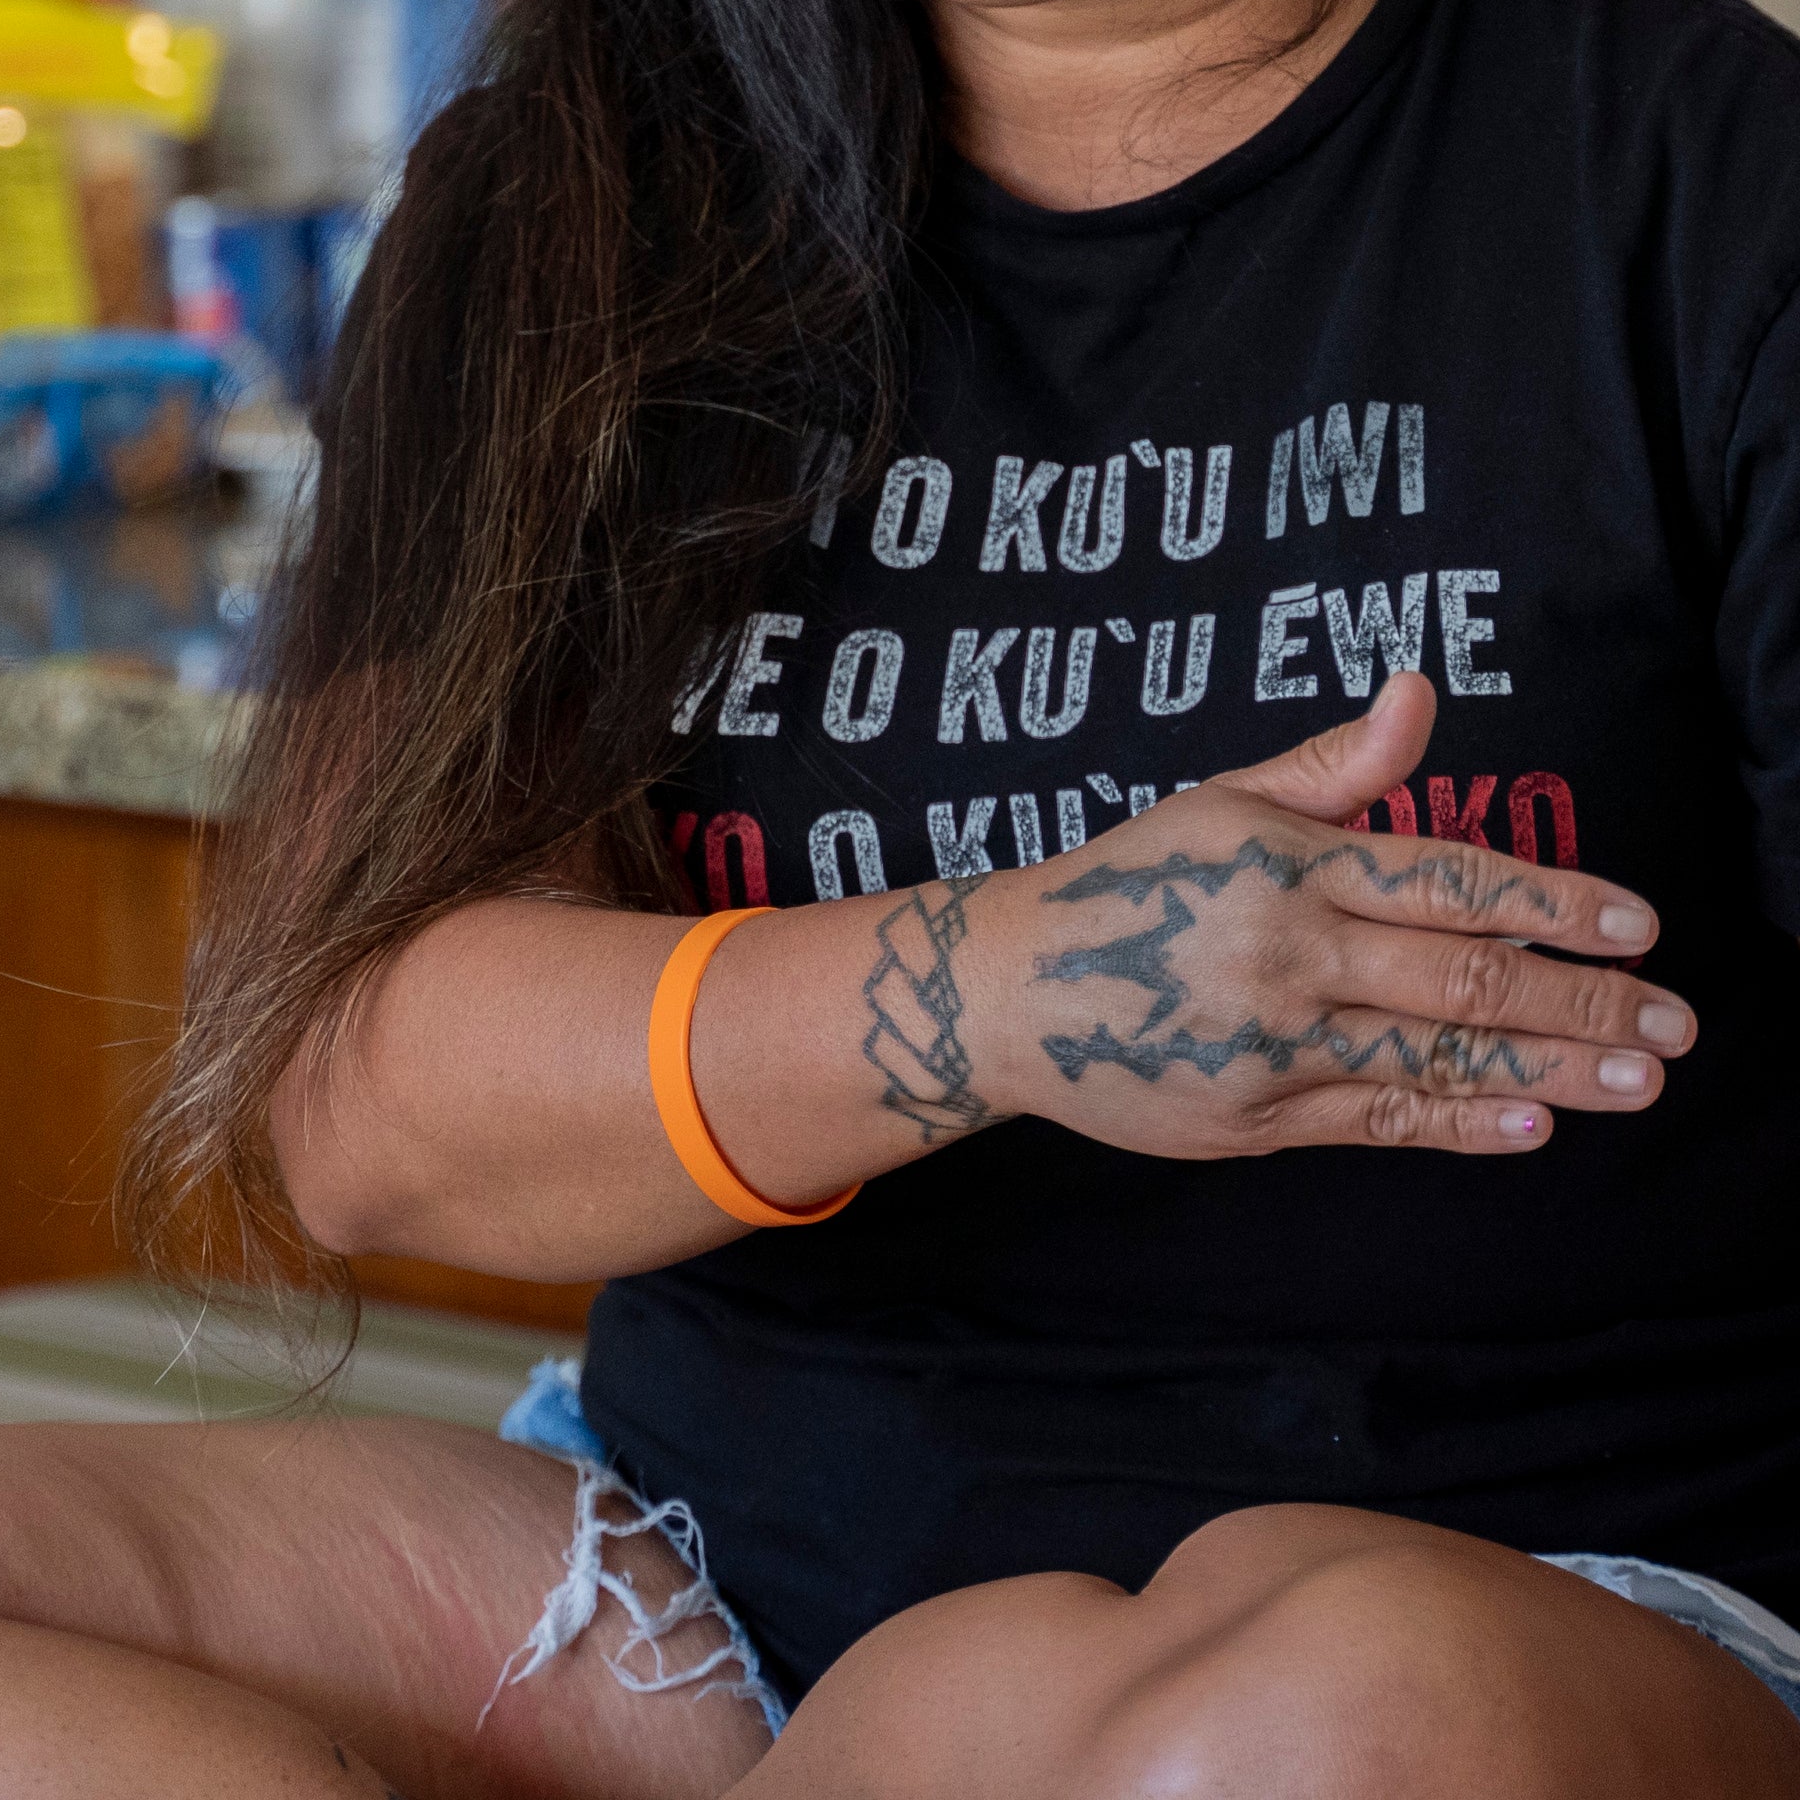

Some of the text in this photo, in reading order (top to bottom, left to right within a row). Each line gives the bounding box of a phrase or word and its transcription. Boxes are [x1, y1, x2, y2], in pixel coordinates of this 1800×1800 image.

[871, 455, 953, 571] O
[1265, 399, 1426, 541] IWI
[822, 627, 905, 744] O
